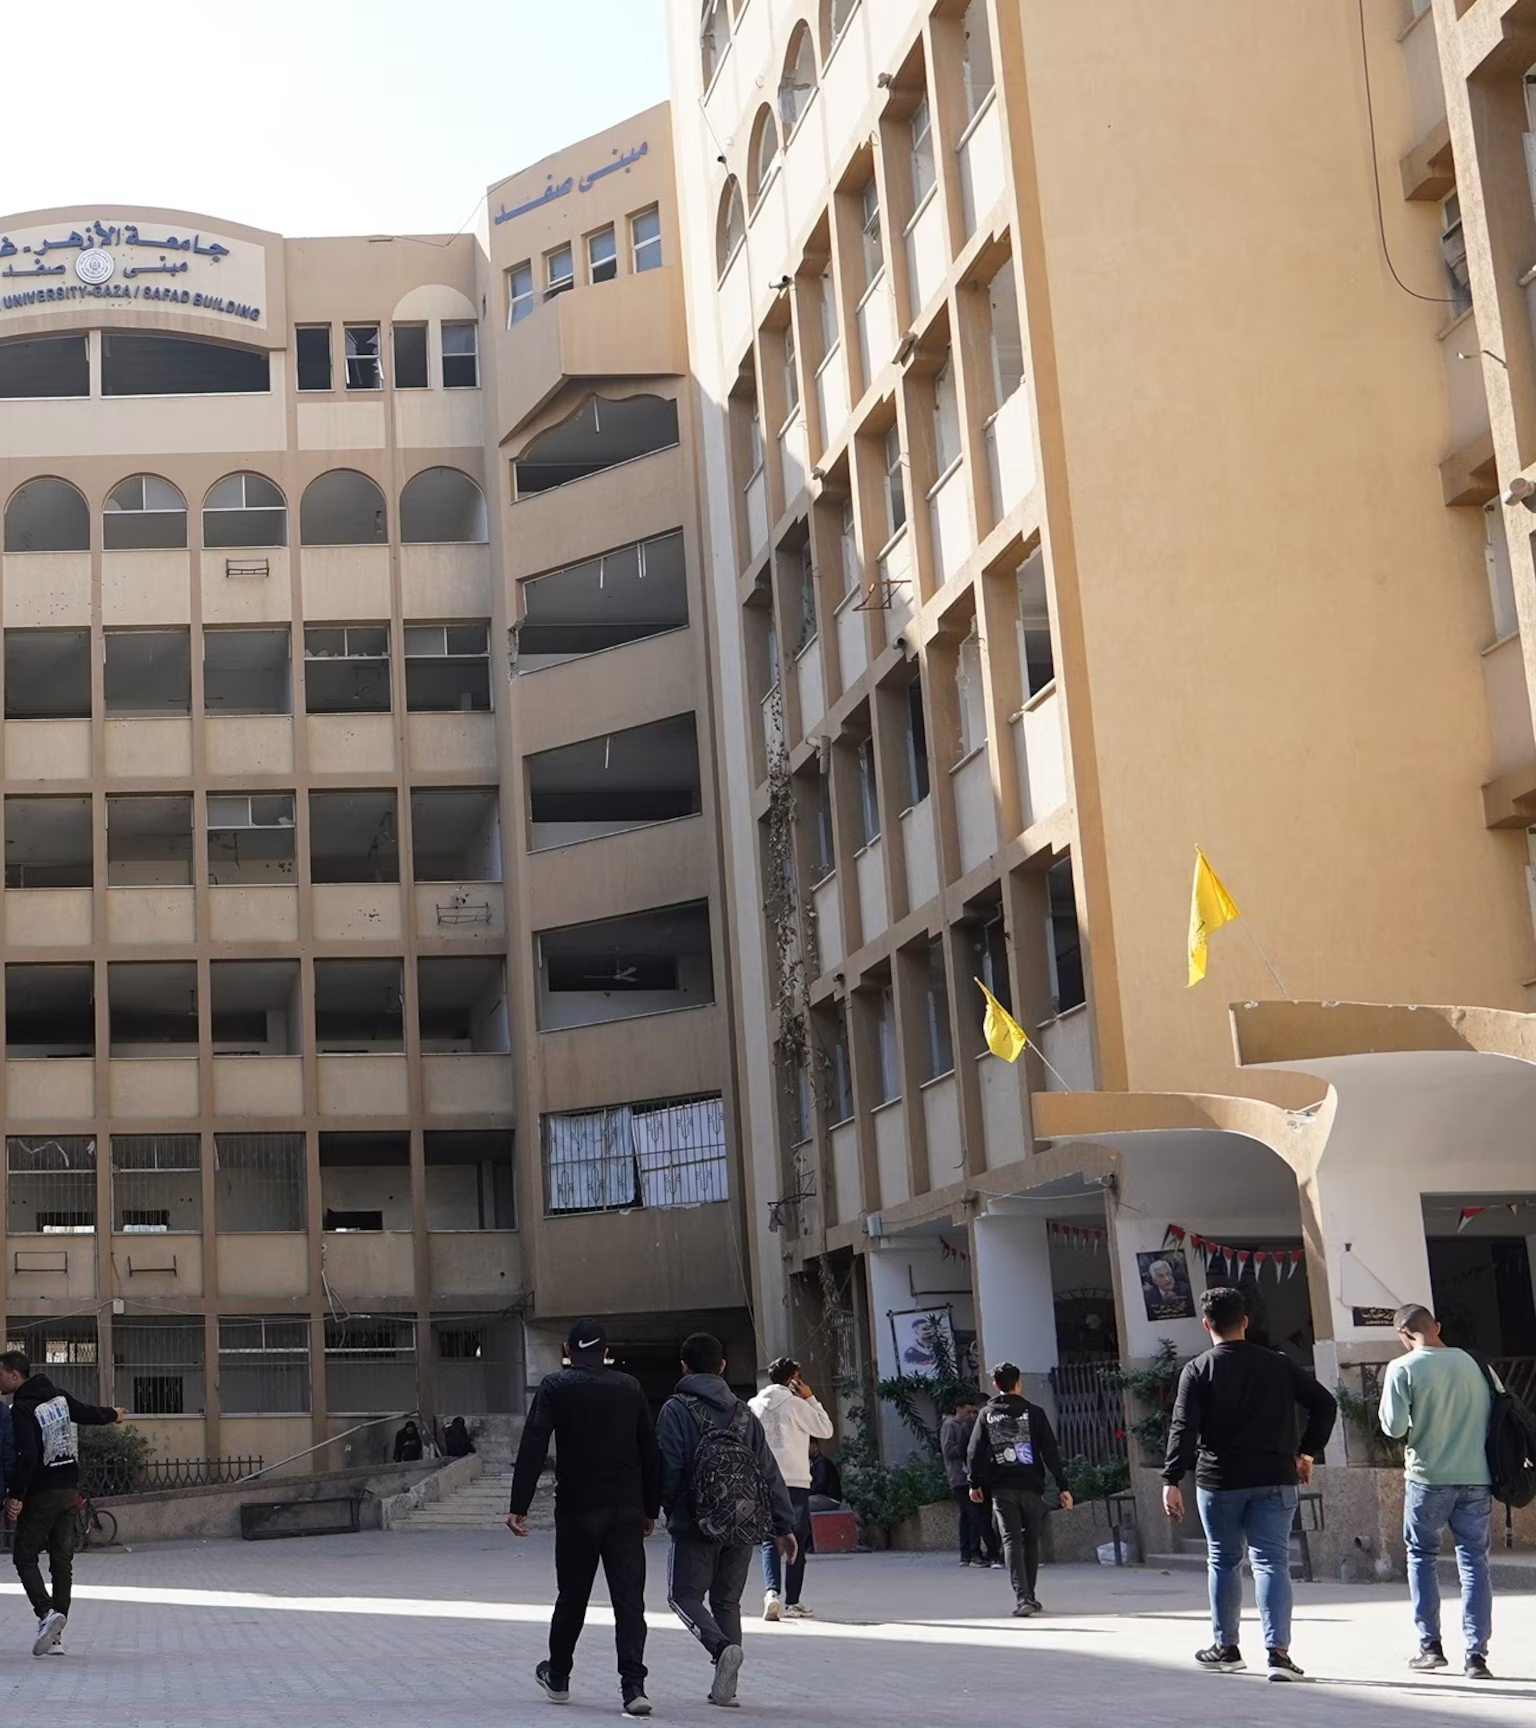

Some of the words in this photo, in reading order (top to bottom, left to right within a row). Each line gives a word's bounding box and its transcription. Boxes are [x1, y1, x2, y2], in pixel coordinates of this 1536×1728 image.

[577, 141, 648, 193] مبنى
[494, 174, 573, 225] صفد
[34, 220, 120, 255] الأزهر
[125, 225, 230, 263] جامعة
[2, 258, 66, 277] صفد
[123, 255, 188, 278] مبنى
[143, 285, 190, 304] SAFAD
[193, 292, 261, 322] BUILDING
